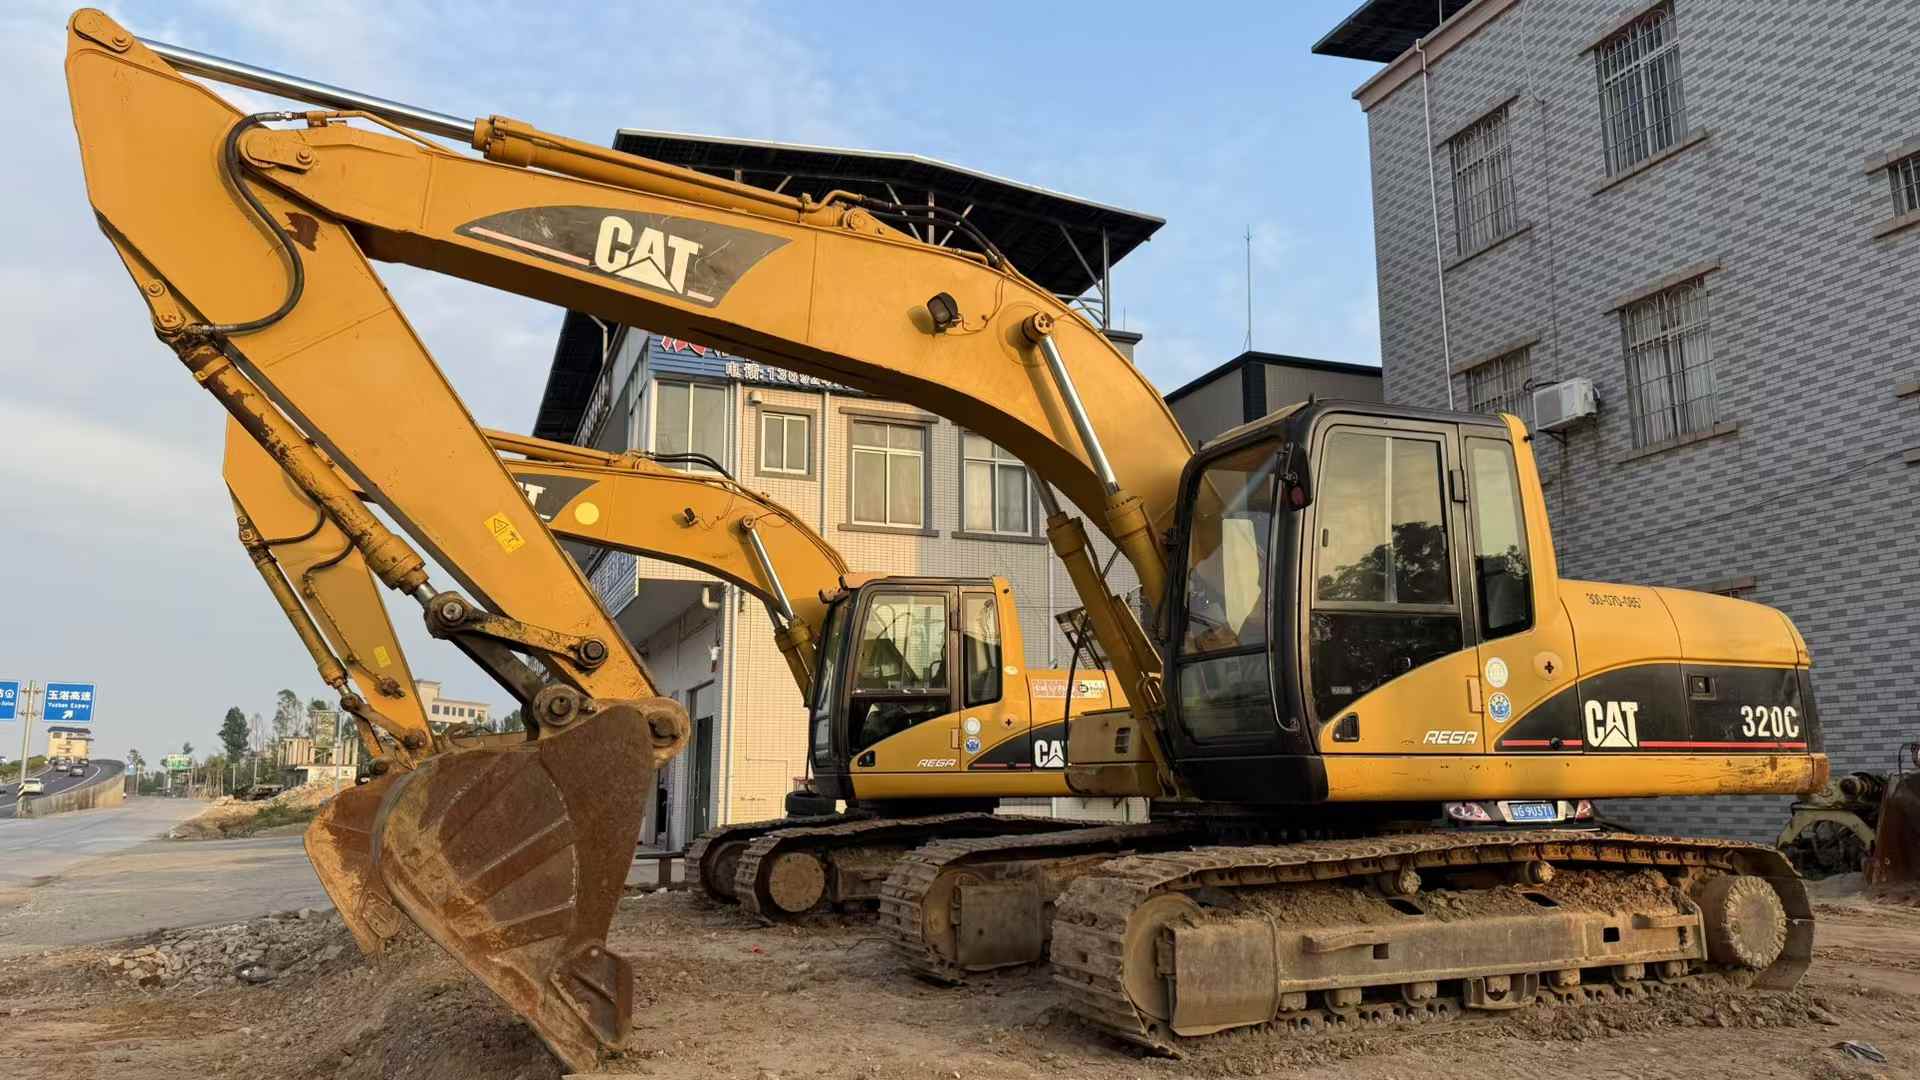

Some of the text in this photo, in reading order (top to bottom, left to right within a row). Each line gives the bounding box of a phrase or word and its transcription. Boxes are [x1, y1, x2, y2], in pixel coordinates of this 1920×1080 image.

[595, 216, 702, 294] CAT
[1423, 730, 1479, 745] REGA
[1584, 699, 1638, 748] CAT
[1741, 706, 1800, 738] 320C
[1034, 739, 1065, 768] CA
